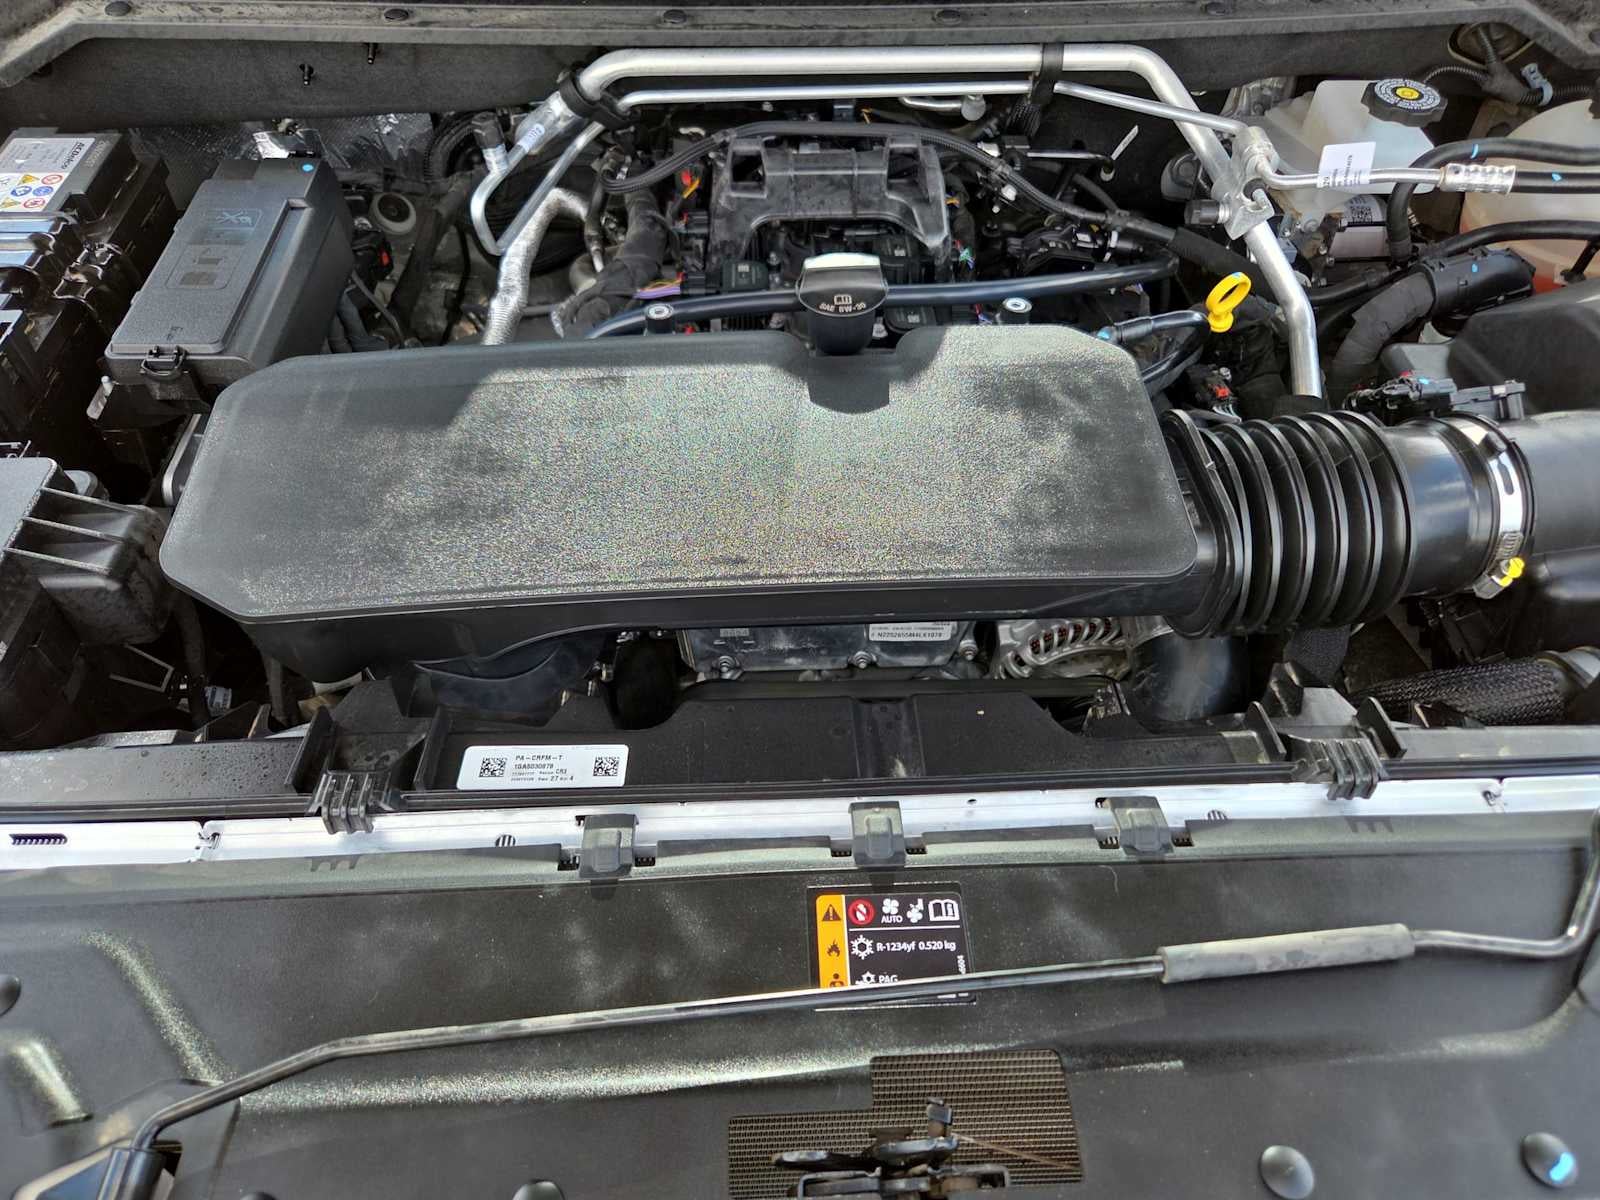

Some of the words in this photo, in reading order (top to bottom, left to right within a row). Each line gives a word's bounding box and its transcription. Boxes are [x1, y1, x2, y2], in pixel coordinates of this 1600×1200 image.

[881, 915, 903, 923] AUTO
[876, 941, 916, 953] R-1234yf
[918, 940, 944, 951] 0.520
[943, 940, 956, 952] kg
[878, 974, 898, 983] PAG
